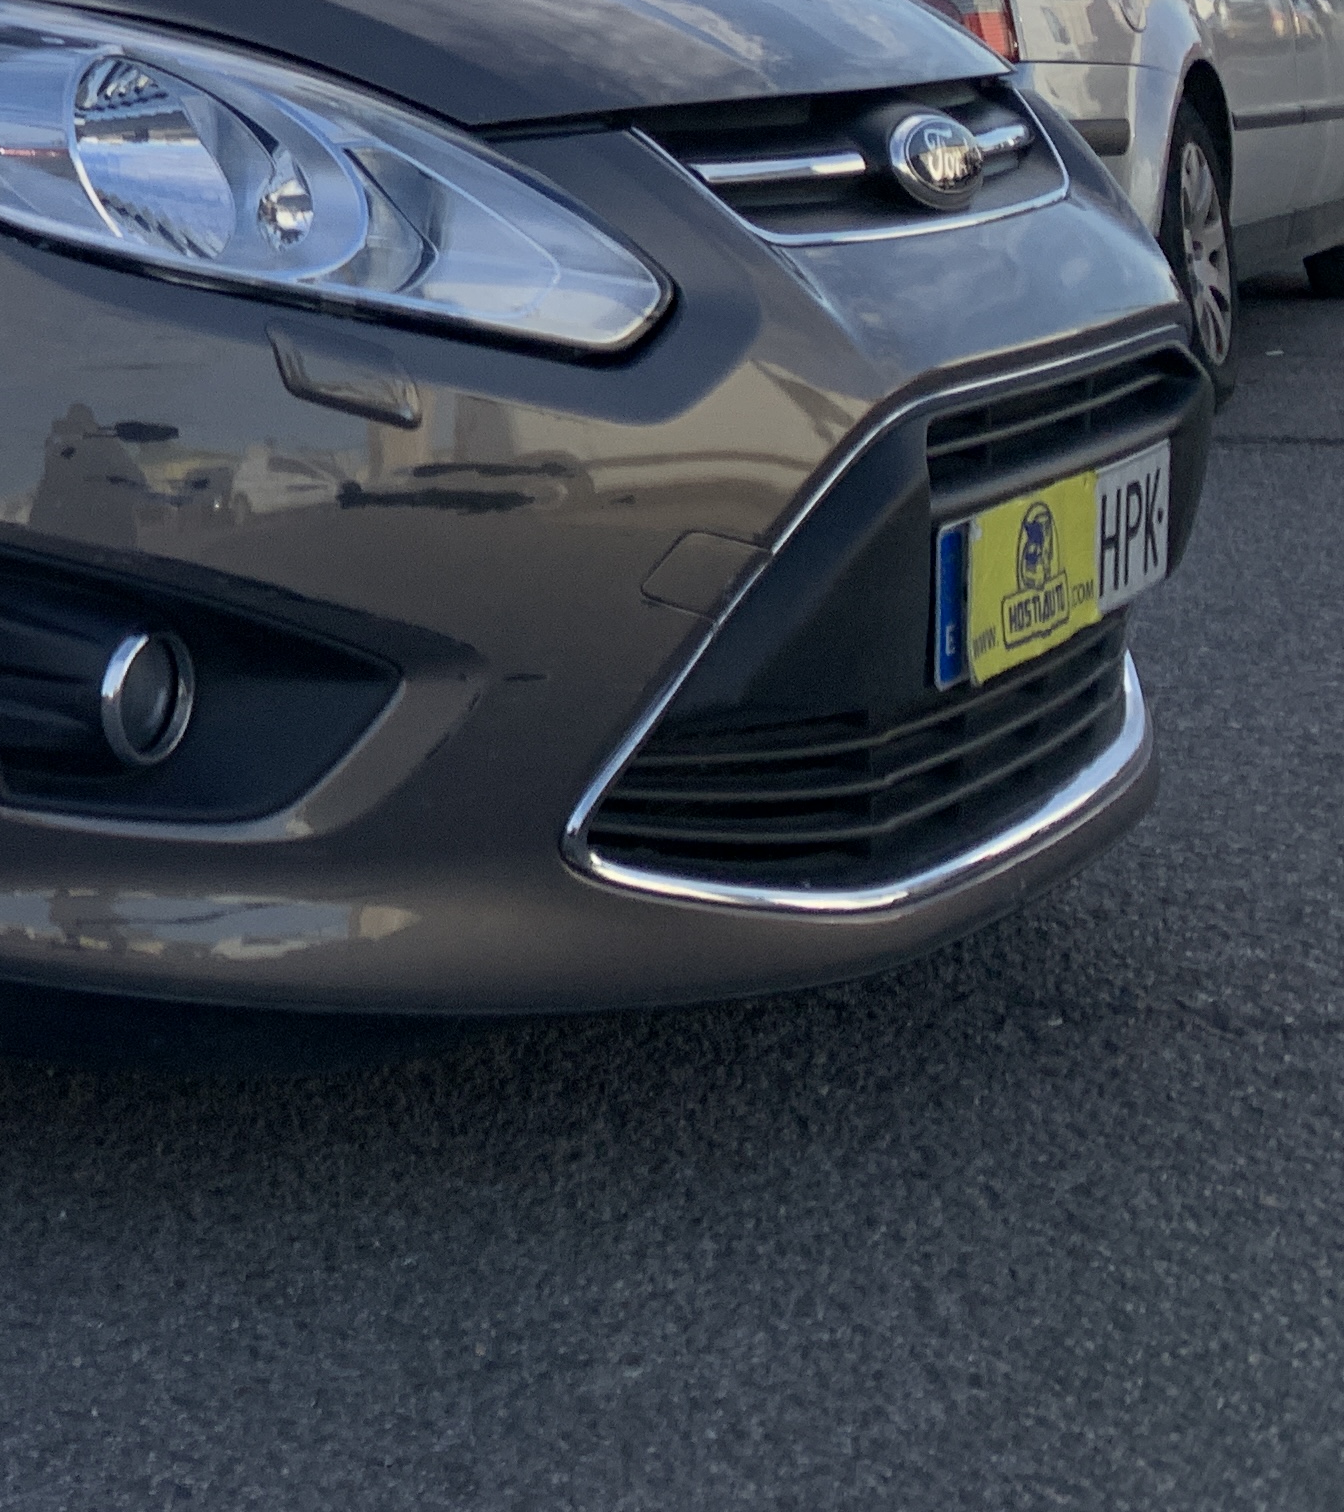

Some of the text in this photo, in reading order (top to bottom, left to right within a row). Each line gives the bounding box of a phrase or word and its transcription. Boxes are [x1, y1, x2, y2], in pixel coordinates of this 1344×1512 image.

[923, 128, 983, 181] Ford
[1099, 468, 1162, 597] HPK
[1008, 583, 1066, 634] HOSTIAUTO
